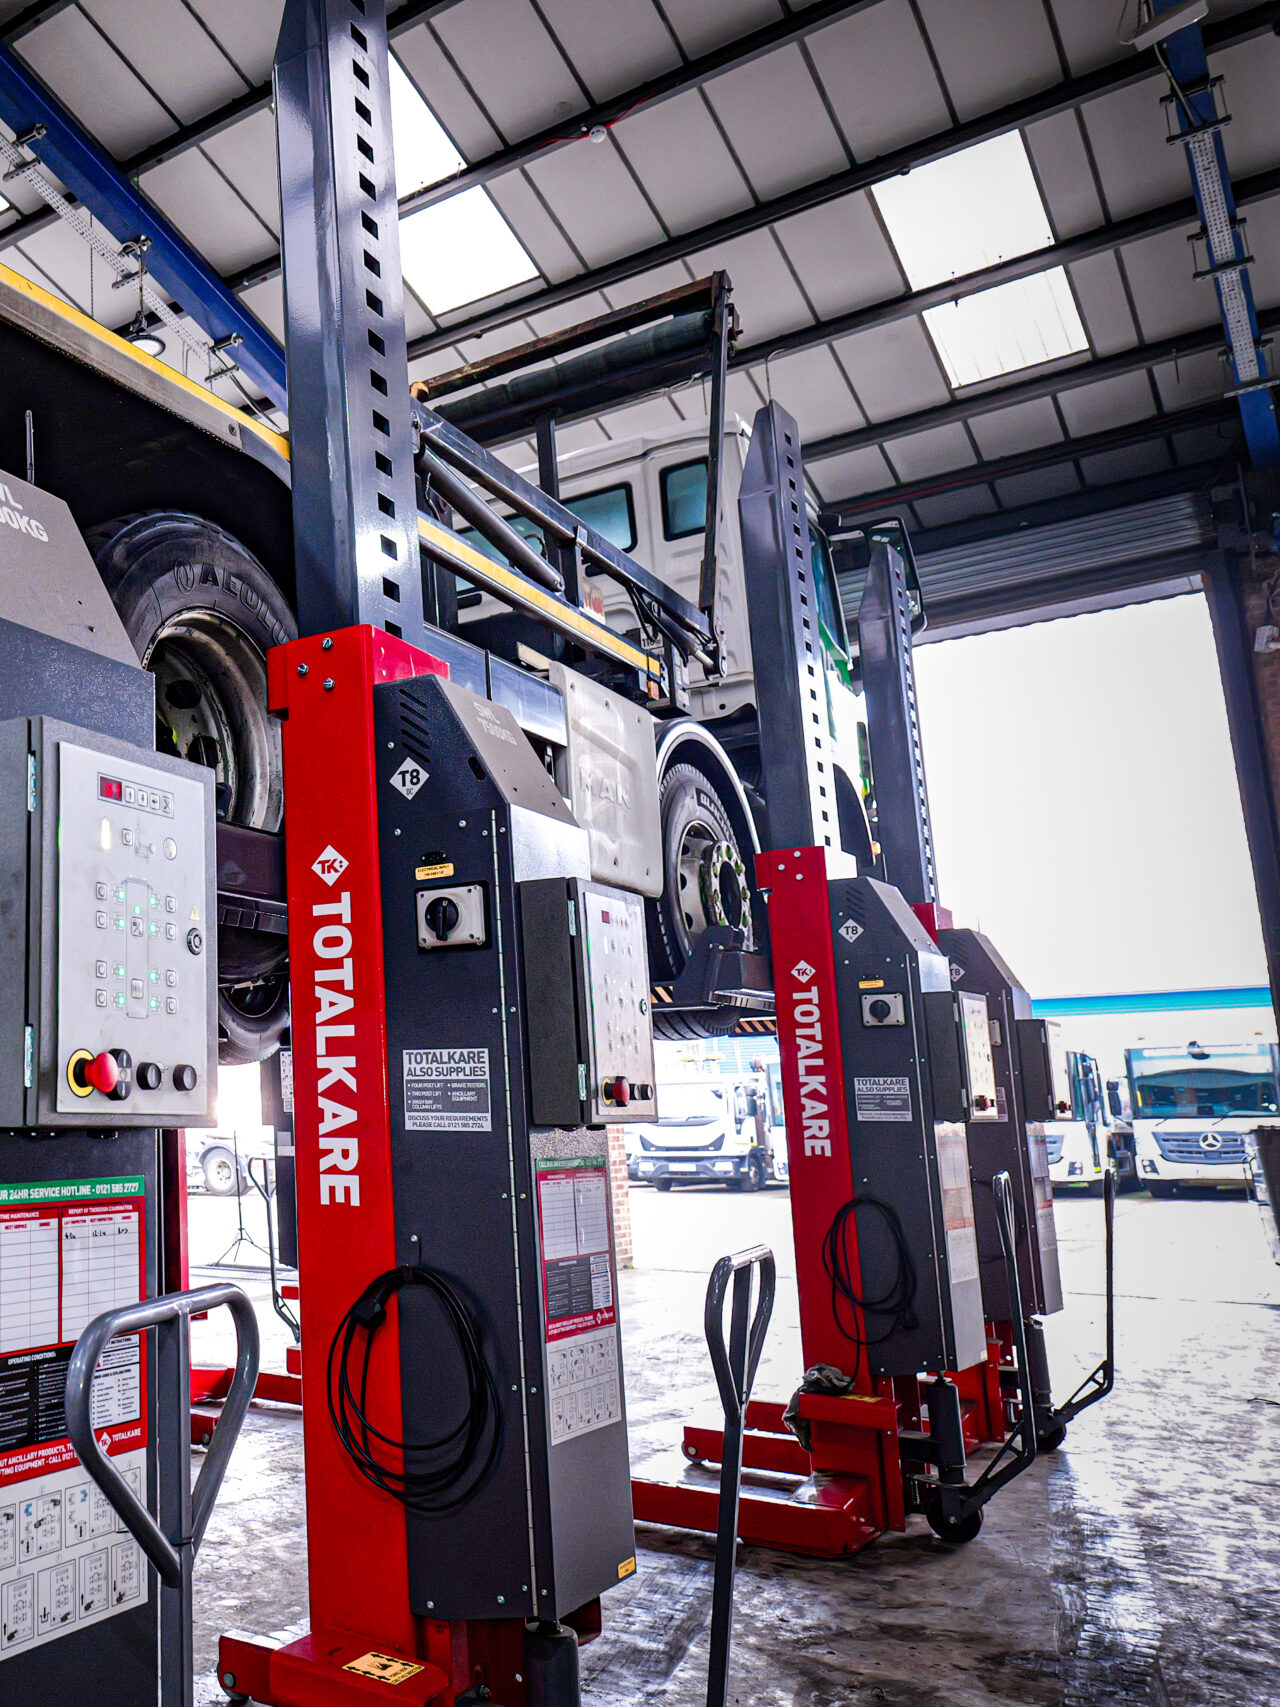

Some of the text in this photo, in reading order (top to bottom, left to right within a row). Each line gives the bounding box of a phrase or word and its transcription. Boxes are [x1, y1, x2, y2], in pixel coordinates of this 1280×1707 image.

[473, 701, 501, 725] SWL
[397, 768, 421, 787] T8
[579, 767, 632, 810] MAN
[312, 890, 361, 1208] TOTALKARE
[406, 1051, 485, 1065] TOTALKARE
[406, 1066, 486, 1077] ALSO SUPPLIES
[792, 986, 832, 1157] TOTALKARE
[9, 1189, 28, 1200] 24HR
[30, 1188, 59, 1199] SERVICE
[61, 1185, 91, 1197] HOTLINE
[96, 1185, 110, 1195] 0121
[124, 1183, 138, 1192] 2727
[112, 1428, 141, 1442] TOTALKARE
[8, 1452, 38, 1464] ANCILLARY
[15, 1460, 45, 1473] EQUIPMENT
[49, 1456, 62, 1464] CALL
